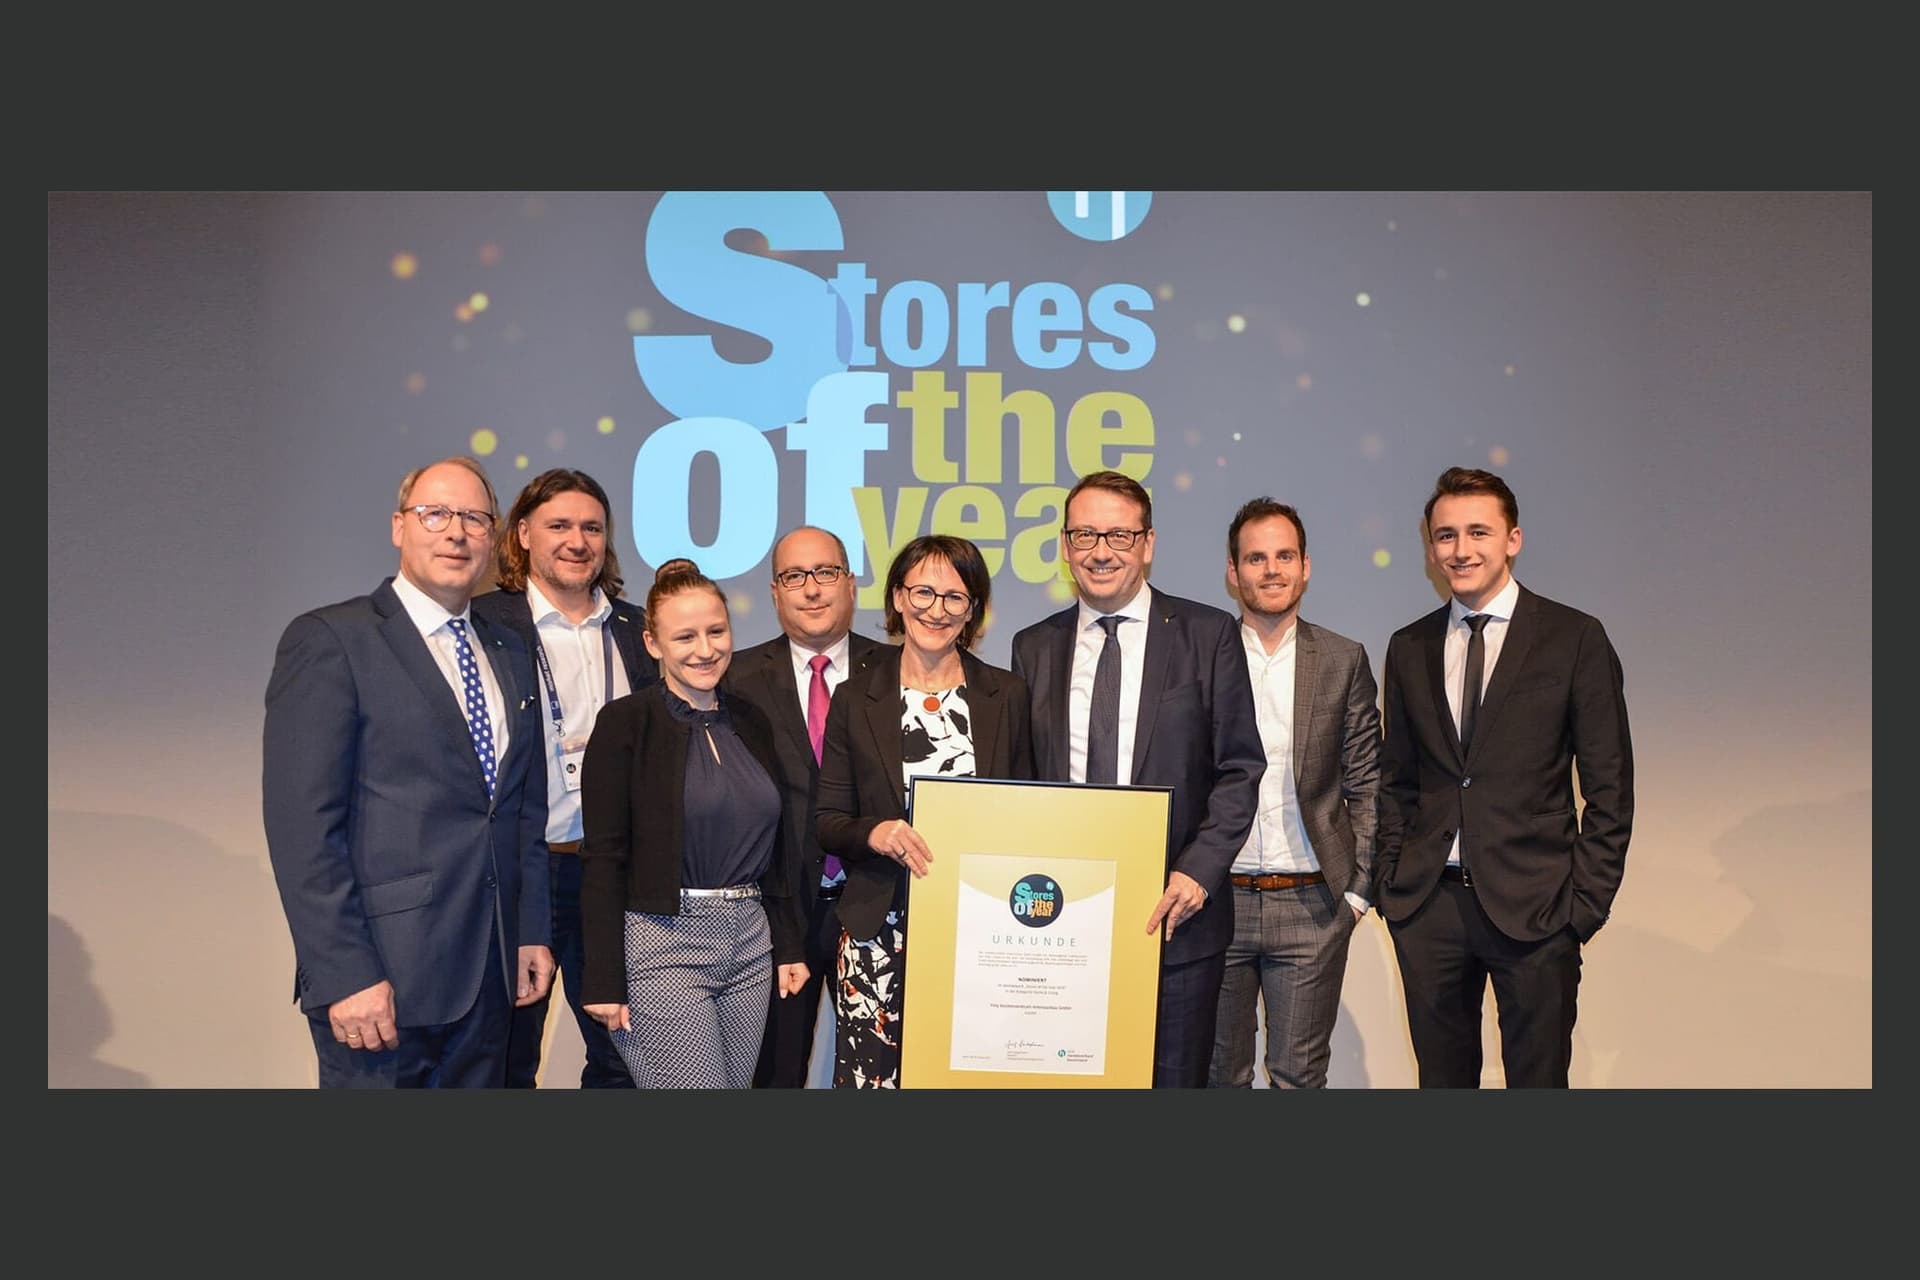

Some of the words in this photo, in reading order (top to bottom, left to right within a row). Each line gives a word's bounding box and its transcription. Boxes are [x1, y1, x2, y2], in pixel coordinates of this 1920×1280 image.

[634, 191, 1156, 432] Stores
[632, 371, 889, 580] of
[897, 371, 1155, 484] the
[851, 484, 1152, 609] yea
[992, 935, 1078, 947] URKUNDE
